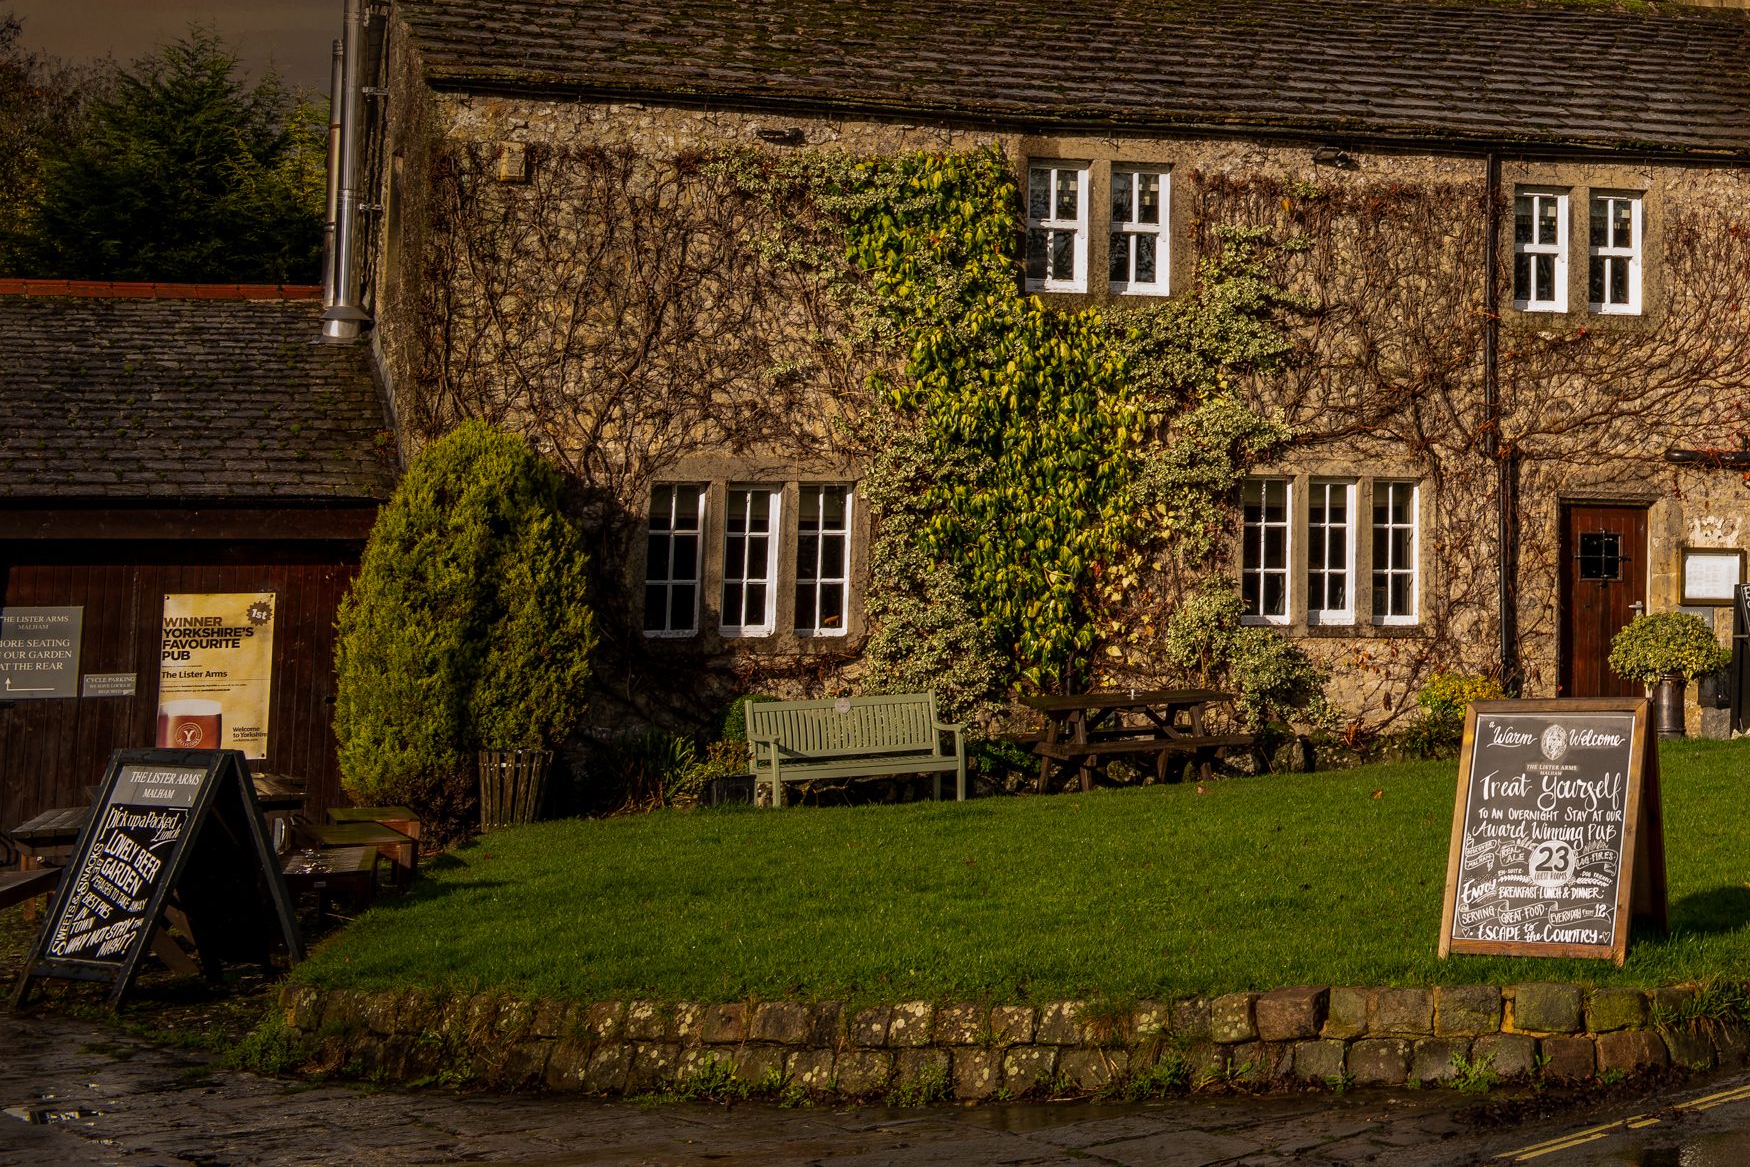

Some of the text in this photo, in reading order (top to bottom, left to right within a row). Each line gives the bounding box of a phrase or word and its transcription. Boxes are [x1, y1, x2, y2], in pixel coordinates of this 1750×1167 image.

[164, 616, 223, 627] WINNER
[251, 608, 268, 620] 1st
[163, 627, 254, 638] YORKSHIRE'S
[27, 638, 70, 647] SEATING
[162, 638, 241, 649] FAVOURITE
[4, 651, 26, 659] OUR
[28, 650, 72, 659] GARDEN
[162, 650, 191, 661] PUB
[12, 662, 33, 671] THE
[35, 662, 64, 670] REAR
[161, 670, 228, 679] The Lister Arms
[1490, 726, 1538, 746] Warm
[1569, 729, 1626, 747] Welcome
[130, 771, 202, 785] THE LISTER ARMS
[142, 788, 175, 799] MALHAM
[1480, 770, 1622, 812] Treat Yourself
[1478, 807, 1622, 823] TO AN OVERNIGHT STAY AT OUR
[1472, 820, 1617, 850] Award Winning PUB
[104, 830, 161, 884] LOVELY BEER
[1535, 846, 1570, 872] 23
[77, 842, 105, 896] SNACKS
[100, 858, 143, 897] GARDEN
[1535, 871, 1568, 881] GUEST ROOMS
[111, 887, 120, 901] TO
[116, 892, 132, 910] TAKE
[127, 898, 148, 912] AWAY
[1563, 887, 1570, 898] &
[74, 906, 90, 922] IN
[82, 892, 114, 919] BEST PIES
[1462, 905, 1495, 924] SERVING
[1550, 908, 1582, 923] EVERYDAY
[1594, 904, 1606, 918] 12
[70, 916, 96, 934] TOWN
[1478, 921, 1539, 940] ESCAPE to
[1524, 923, 1597, 943] the COUNTRY
[65, 932, 92, 954] WHY
[86, 926, 111, 947] NOT
[105, 917, 136, 940] STAY
[96, 931, 137, 958] NIGHT?
